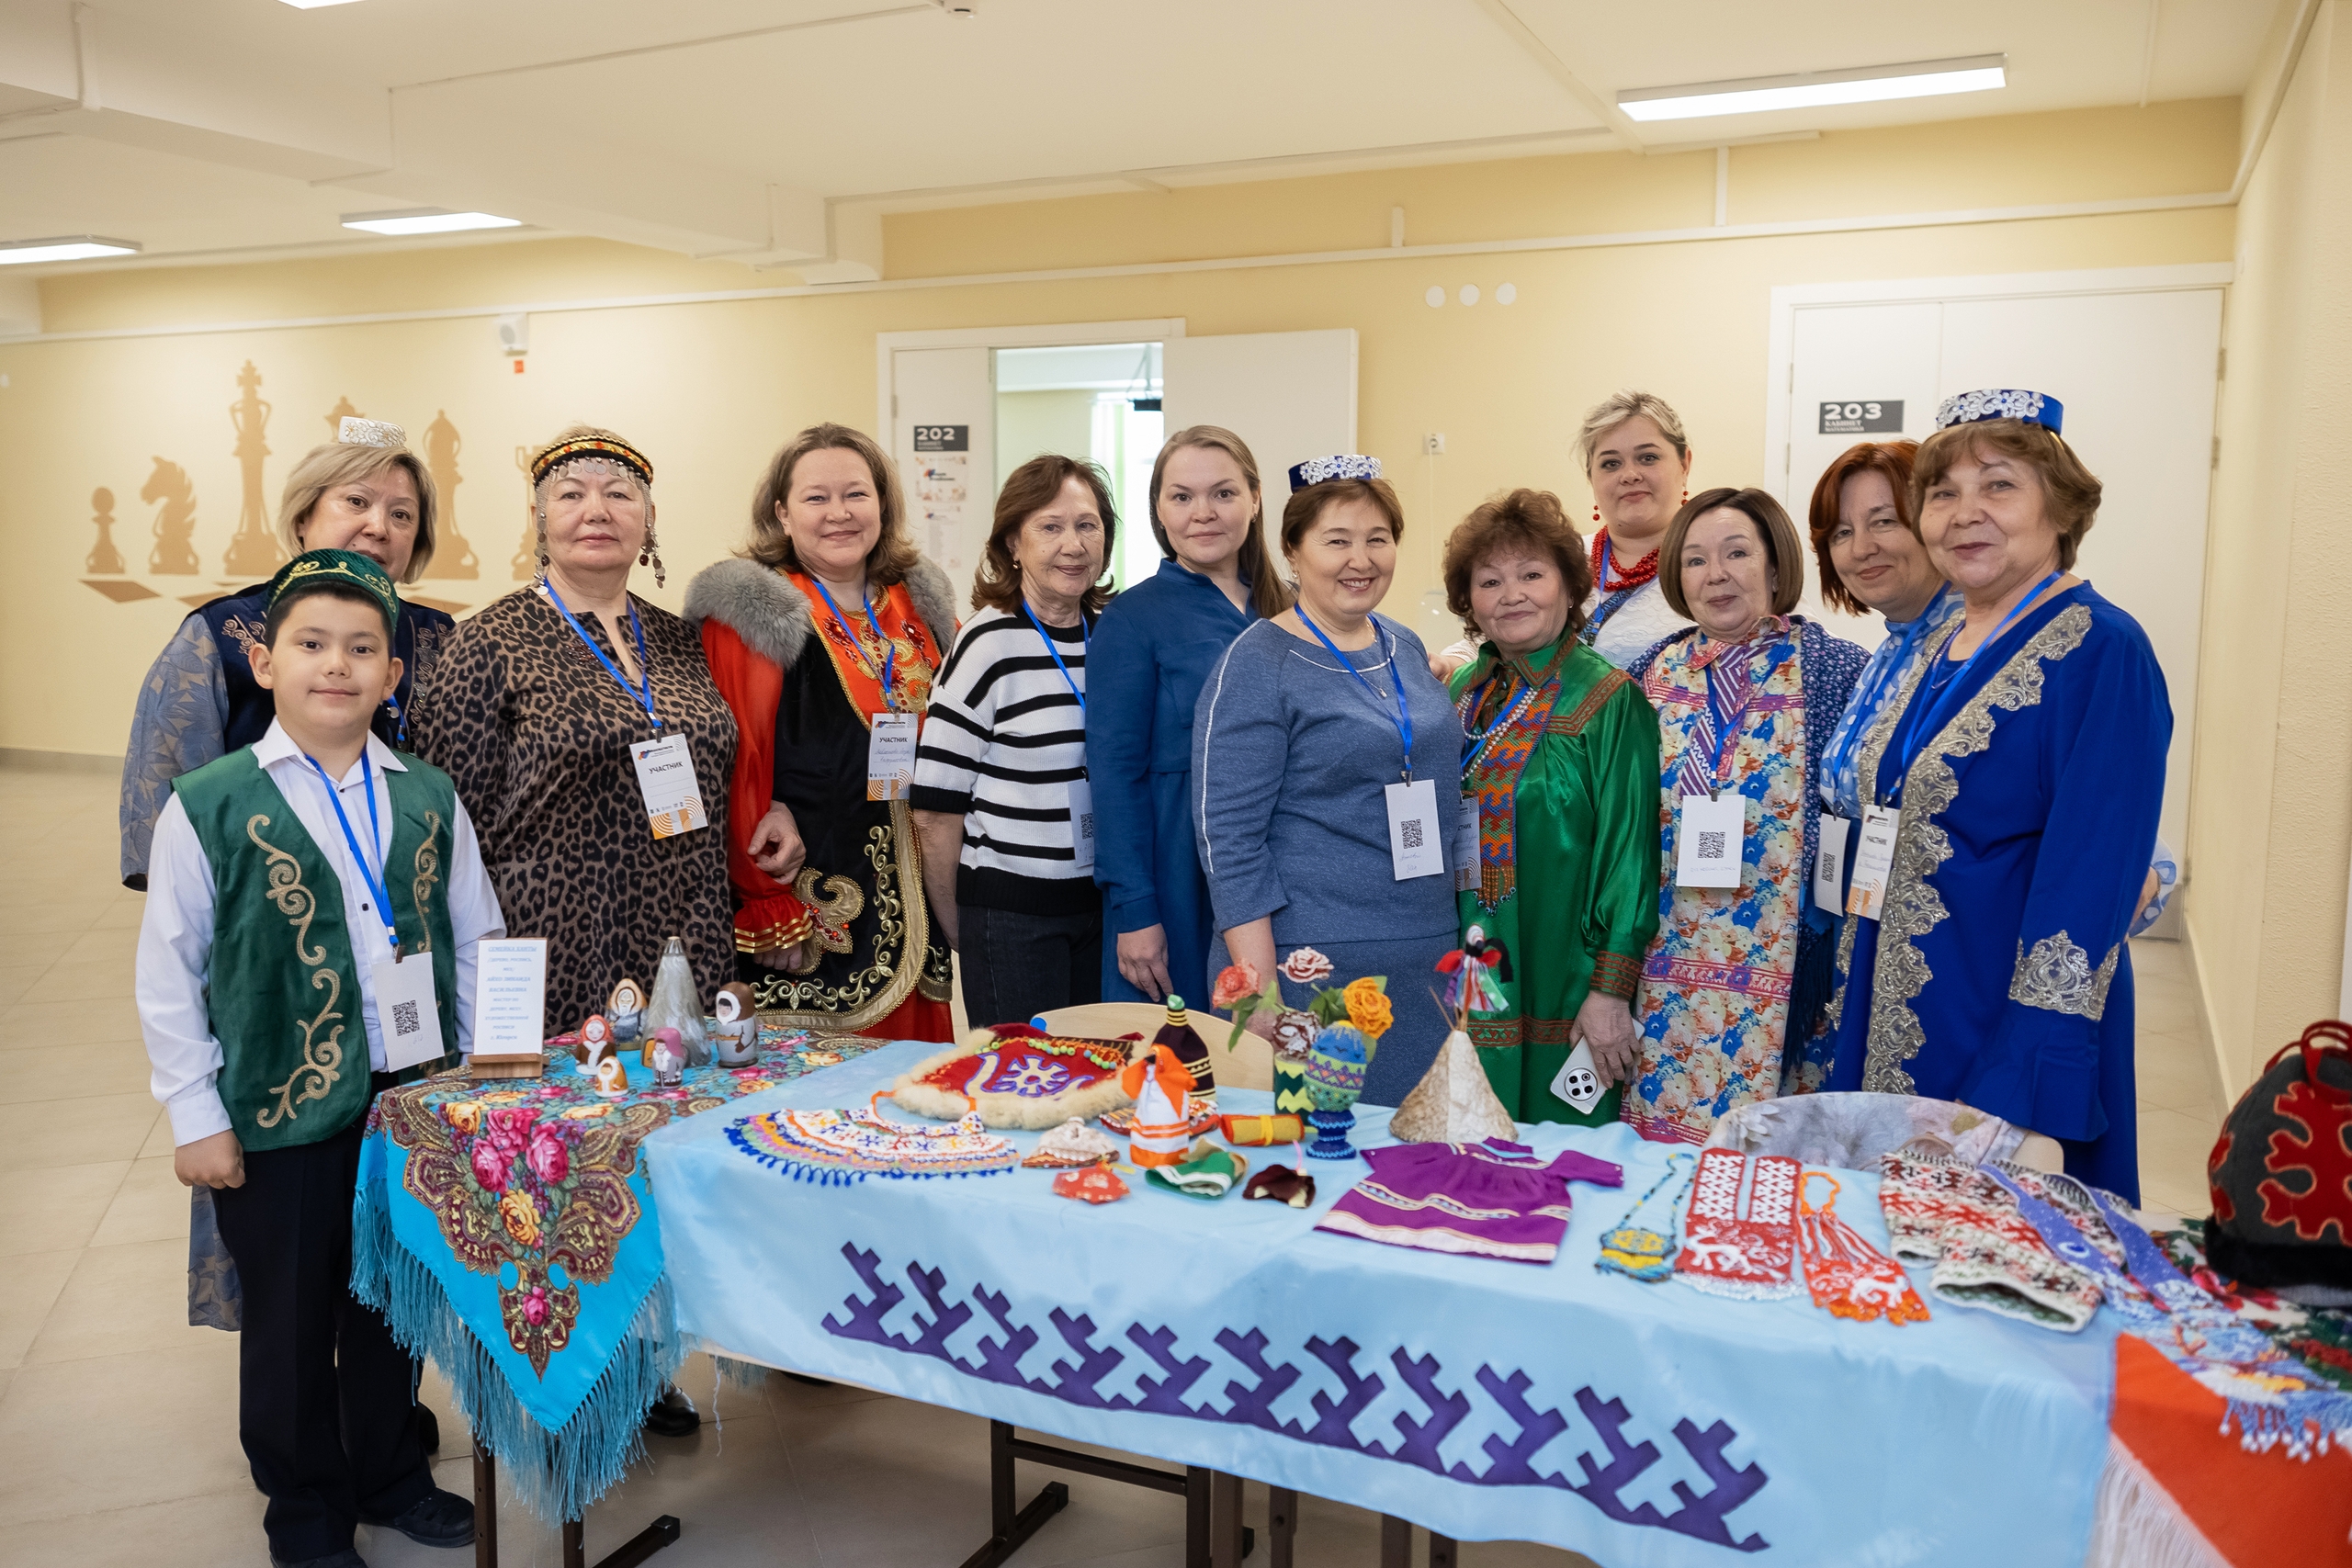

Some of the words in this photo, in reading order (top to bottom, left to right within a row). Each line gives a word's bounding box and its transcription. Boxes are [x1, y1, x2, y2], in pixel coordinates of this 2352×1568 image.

[1825, 402, 1882, 420] 203
[917, 427, 955, 441] 202
[649, 761, 684, 774] УЧАСТНИК
